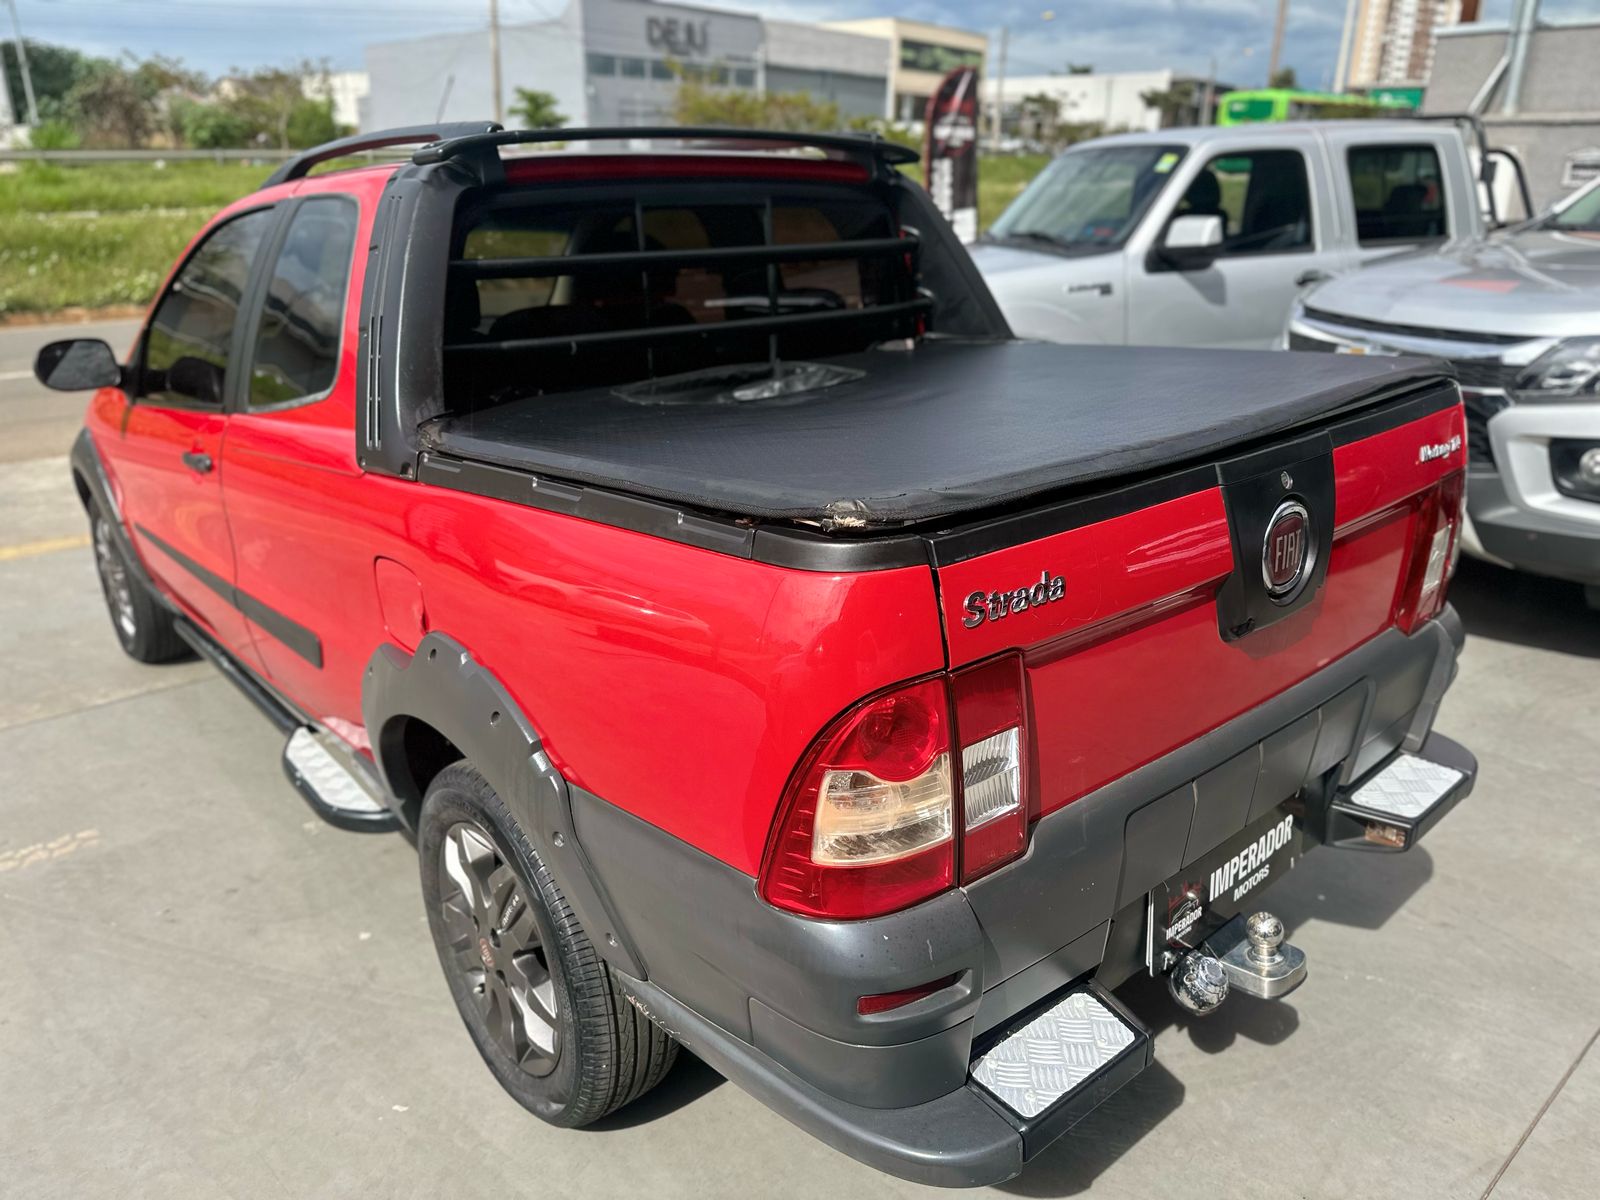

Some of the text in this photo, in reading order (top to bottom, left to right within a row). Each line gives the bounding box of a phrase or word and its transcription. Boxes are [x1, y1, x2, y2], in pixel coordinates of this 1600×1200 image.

[1275, 529, 1302, 573] FIAT
[962, 570, 1066, 629] Strada
[1209, 814, 1294, 902] IMPERADOR
[1233, 864, 1270, 902] MOTORS
[1166, 906, 1203, 941] IMPERADOR
